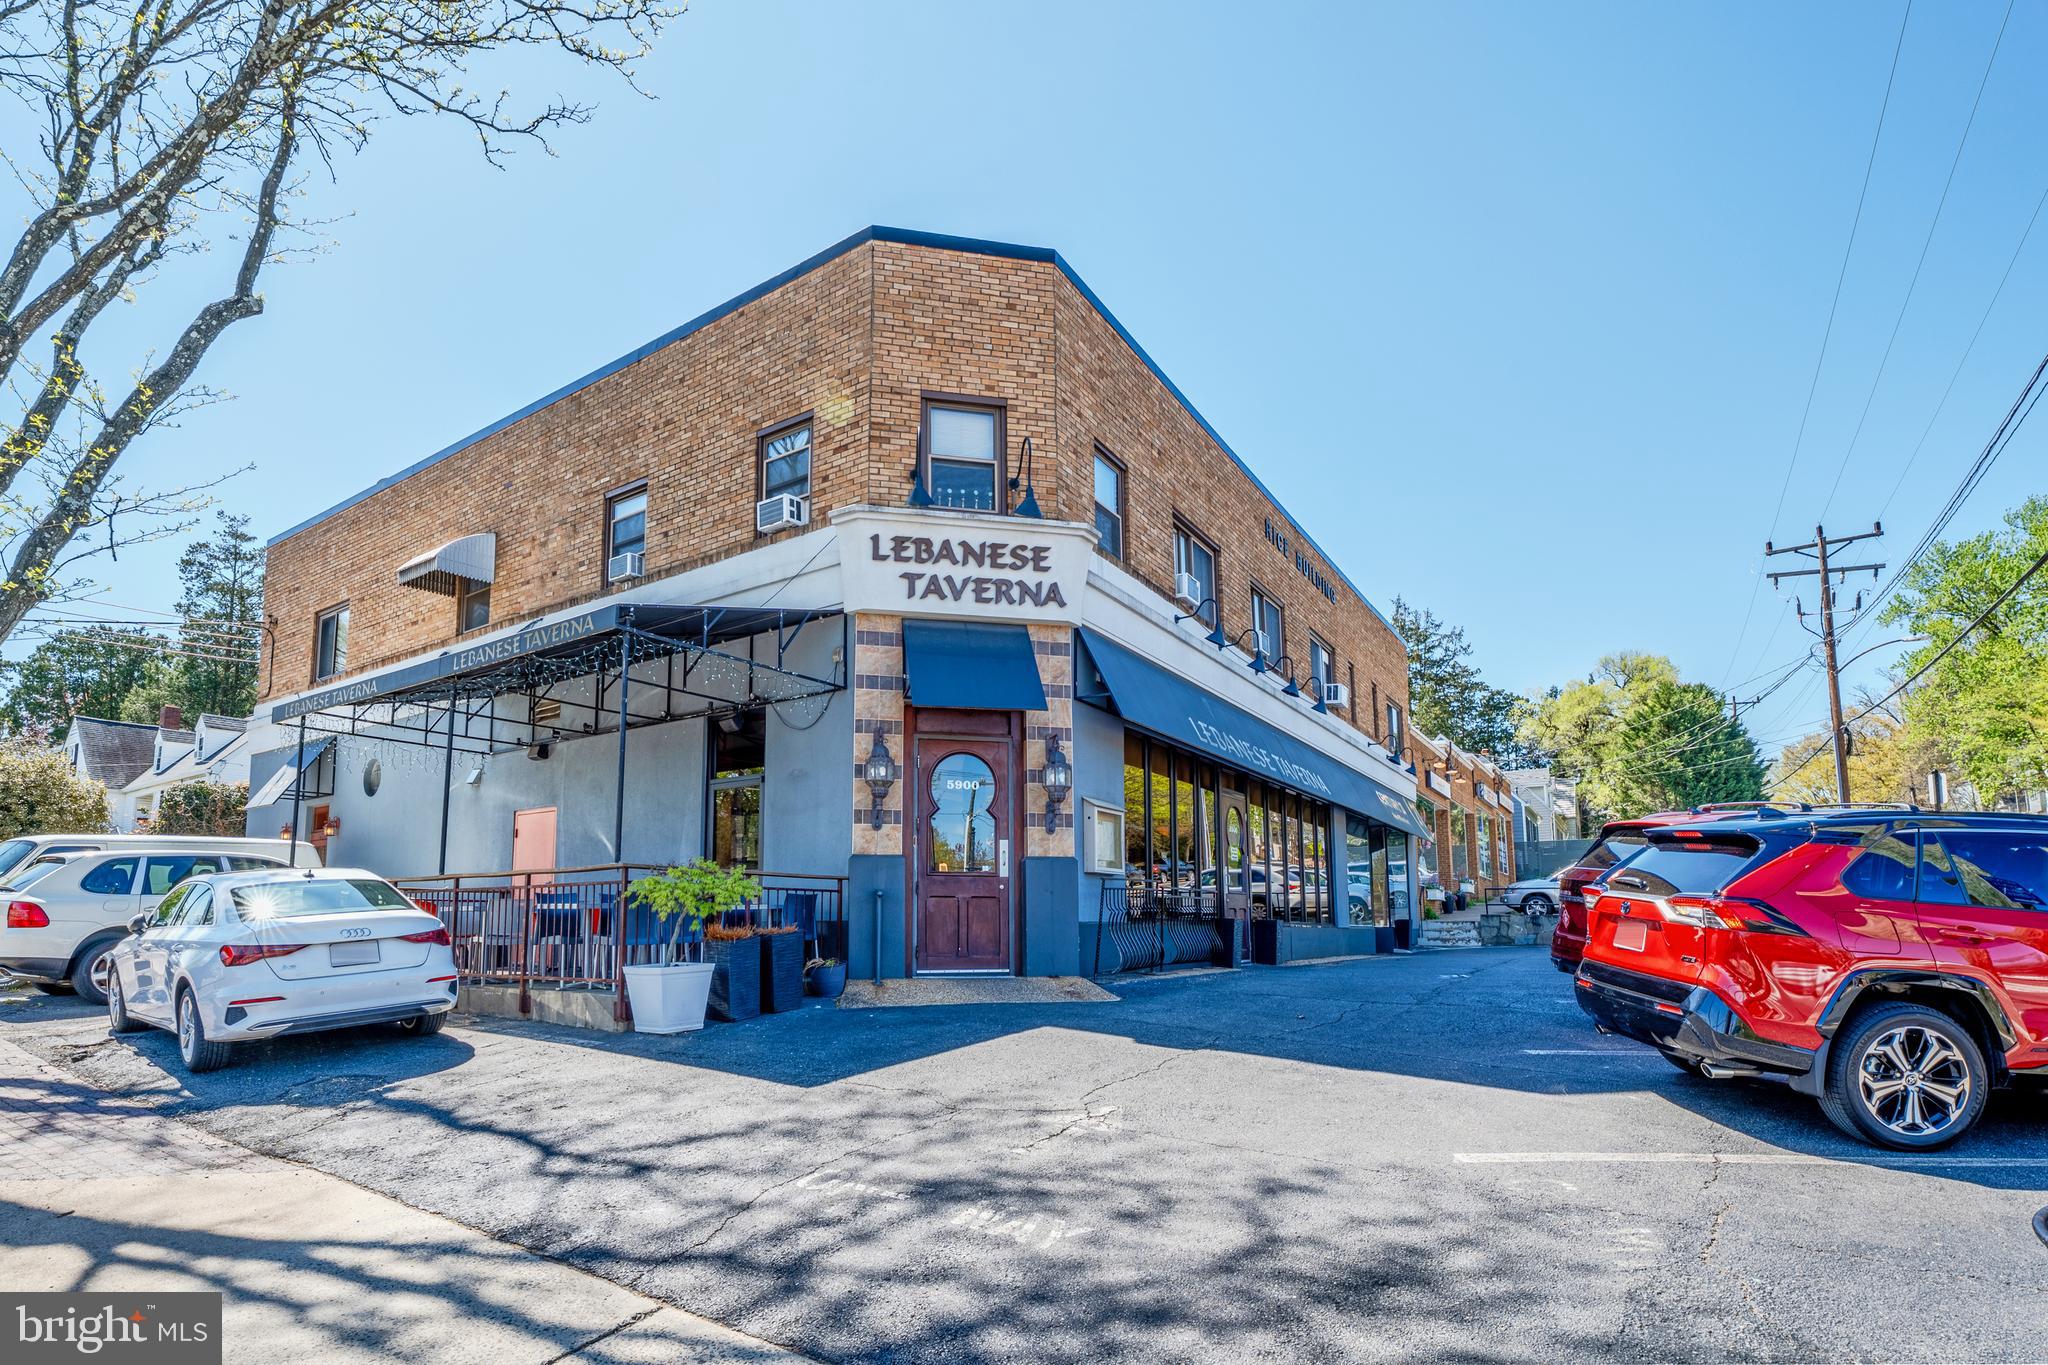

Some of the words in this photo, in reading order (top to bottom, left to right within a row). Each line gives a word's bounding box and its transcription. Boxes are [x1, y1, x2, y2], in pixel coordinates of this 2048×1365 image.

[870, 533, 1052, 572] LEBANESE
[1265, 517, 1288, 559] RICE
[1296, 551, 1336, 605] BUILDING
[899, 572, 1067, 608] TAVERNA
[453, 637, 520, 670] LEBANESE
[525, 615, 594, 649] TAVERNA
[285, 693, 330, 718] LEBANESE
[333, 680, 377, 704] TAVERNA
[1188, 717, 1277, 772] LEBANESE
[1271, 754, 1332, 795] TAVERNA
[947, 780, 980, 790] 5900
